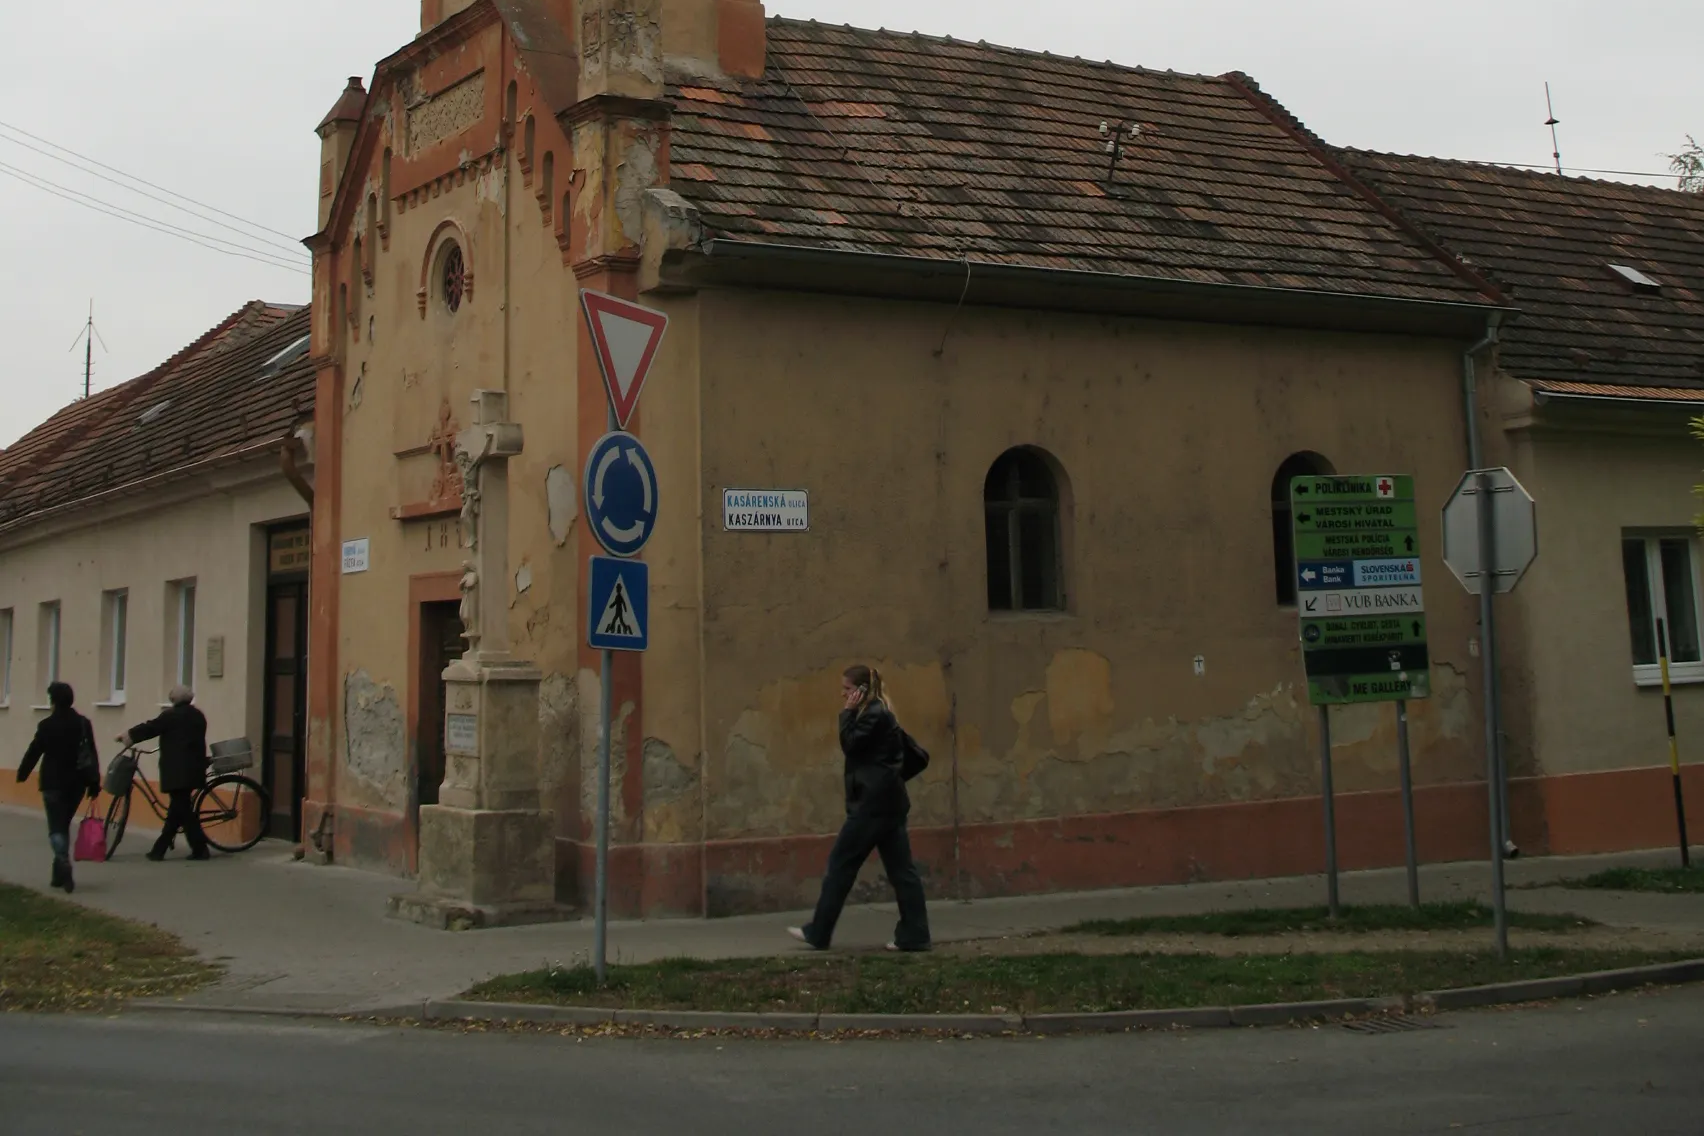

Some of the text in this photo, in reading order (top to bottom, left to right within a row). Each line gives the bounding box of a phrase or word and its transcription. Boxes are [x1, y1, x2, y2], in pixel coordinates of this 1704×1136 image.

[1315, 482, 1372, 494] POLIKLINIKA
[727, 493, 806, 508] KASÁRENSKÁ ULICA
[1316, 504, 1392, 516] MESTSKÝ ÚRAD
[728, 511, 804, 526] KASZÁRNYA UTCA
[1322, 566, 1345, 575] Banka
[1323, 575, 1342, 583] Bank
[1345, 591, 1420, 609] VÚB BANKA
[1371, 680, 1412, 694] GALLERY
